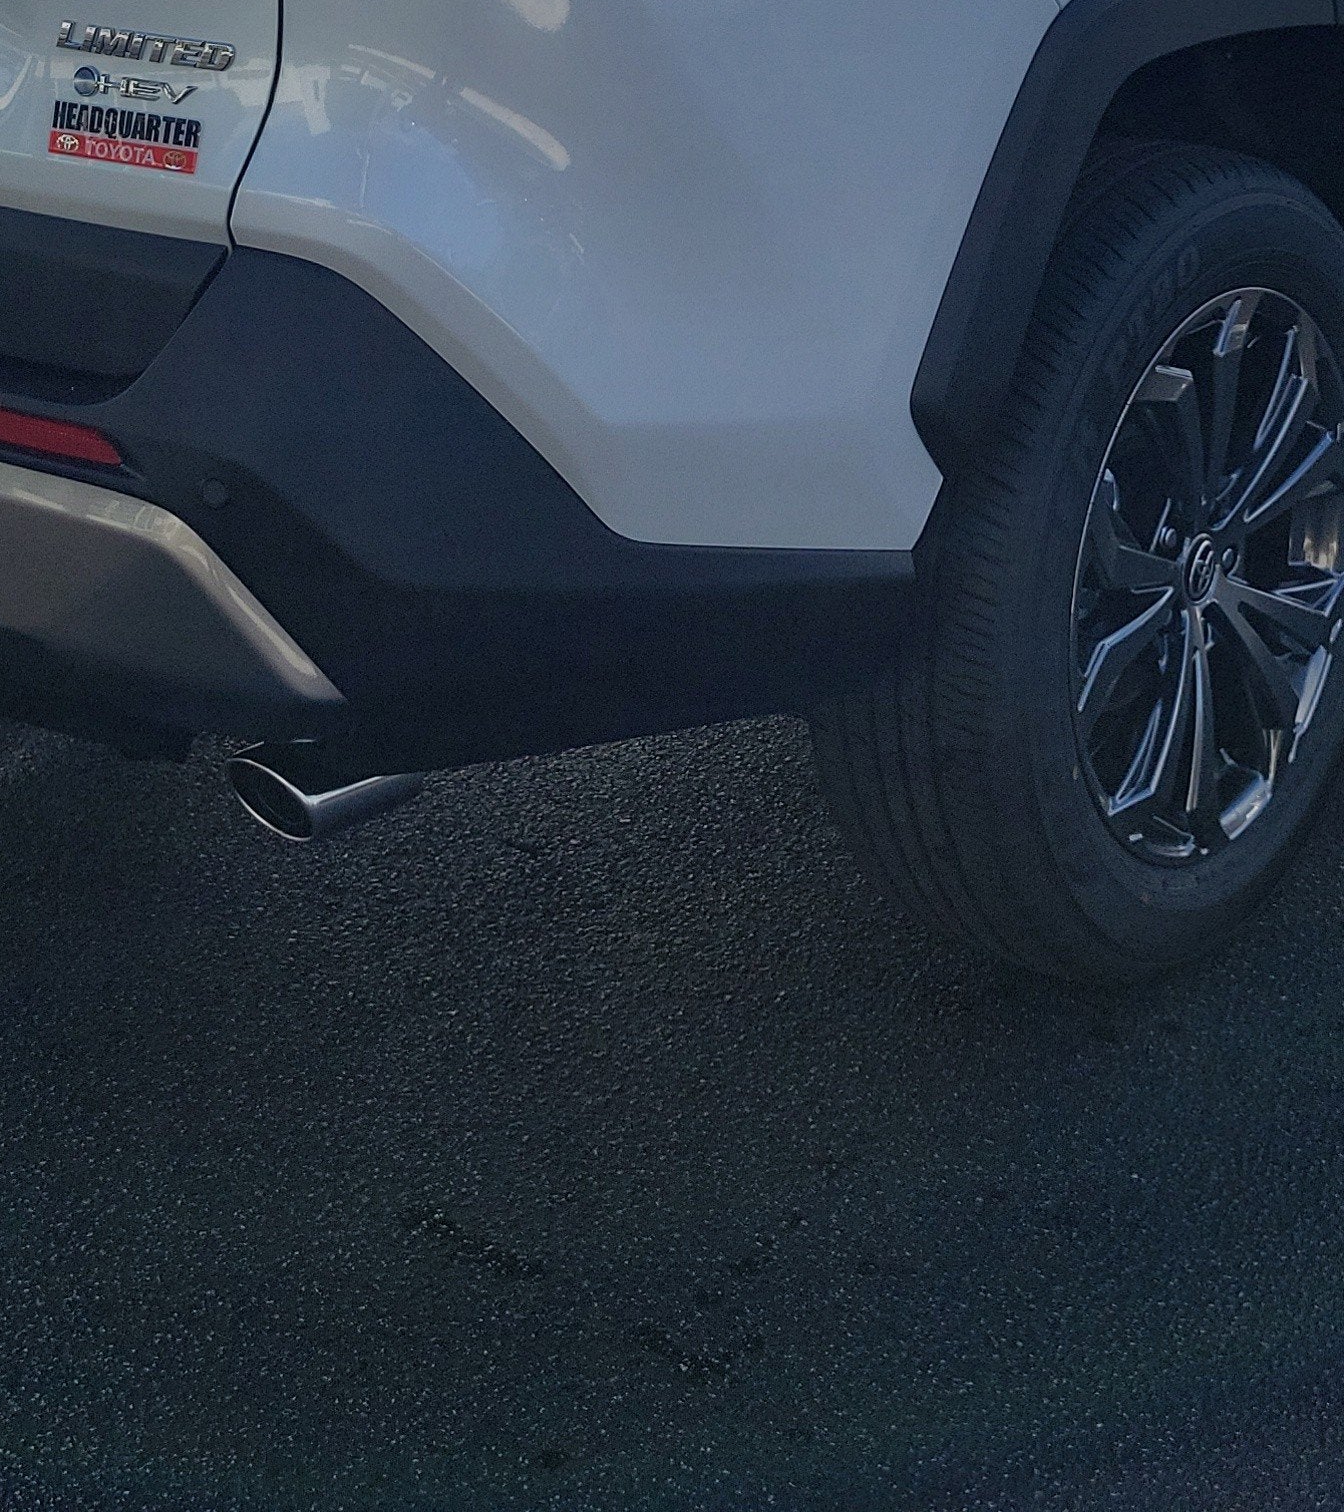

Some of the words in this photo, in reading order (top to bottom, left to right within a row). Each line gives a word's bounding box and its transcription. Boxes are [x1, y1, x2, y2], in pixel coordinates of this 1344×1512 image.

[56, 19, 236, 72] LIMITED
[52, 99, 203, 148] HEADQUARTER
[84, 137, 156, 166] TOYOTA
